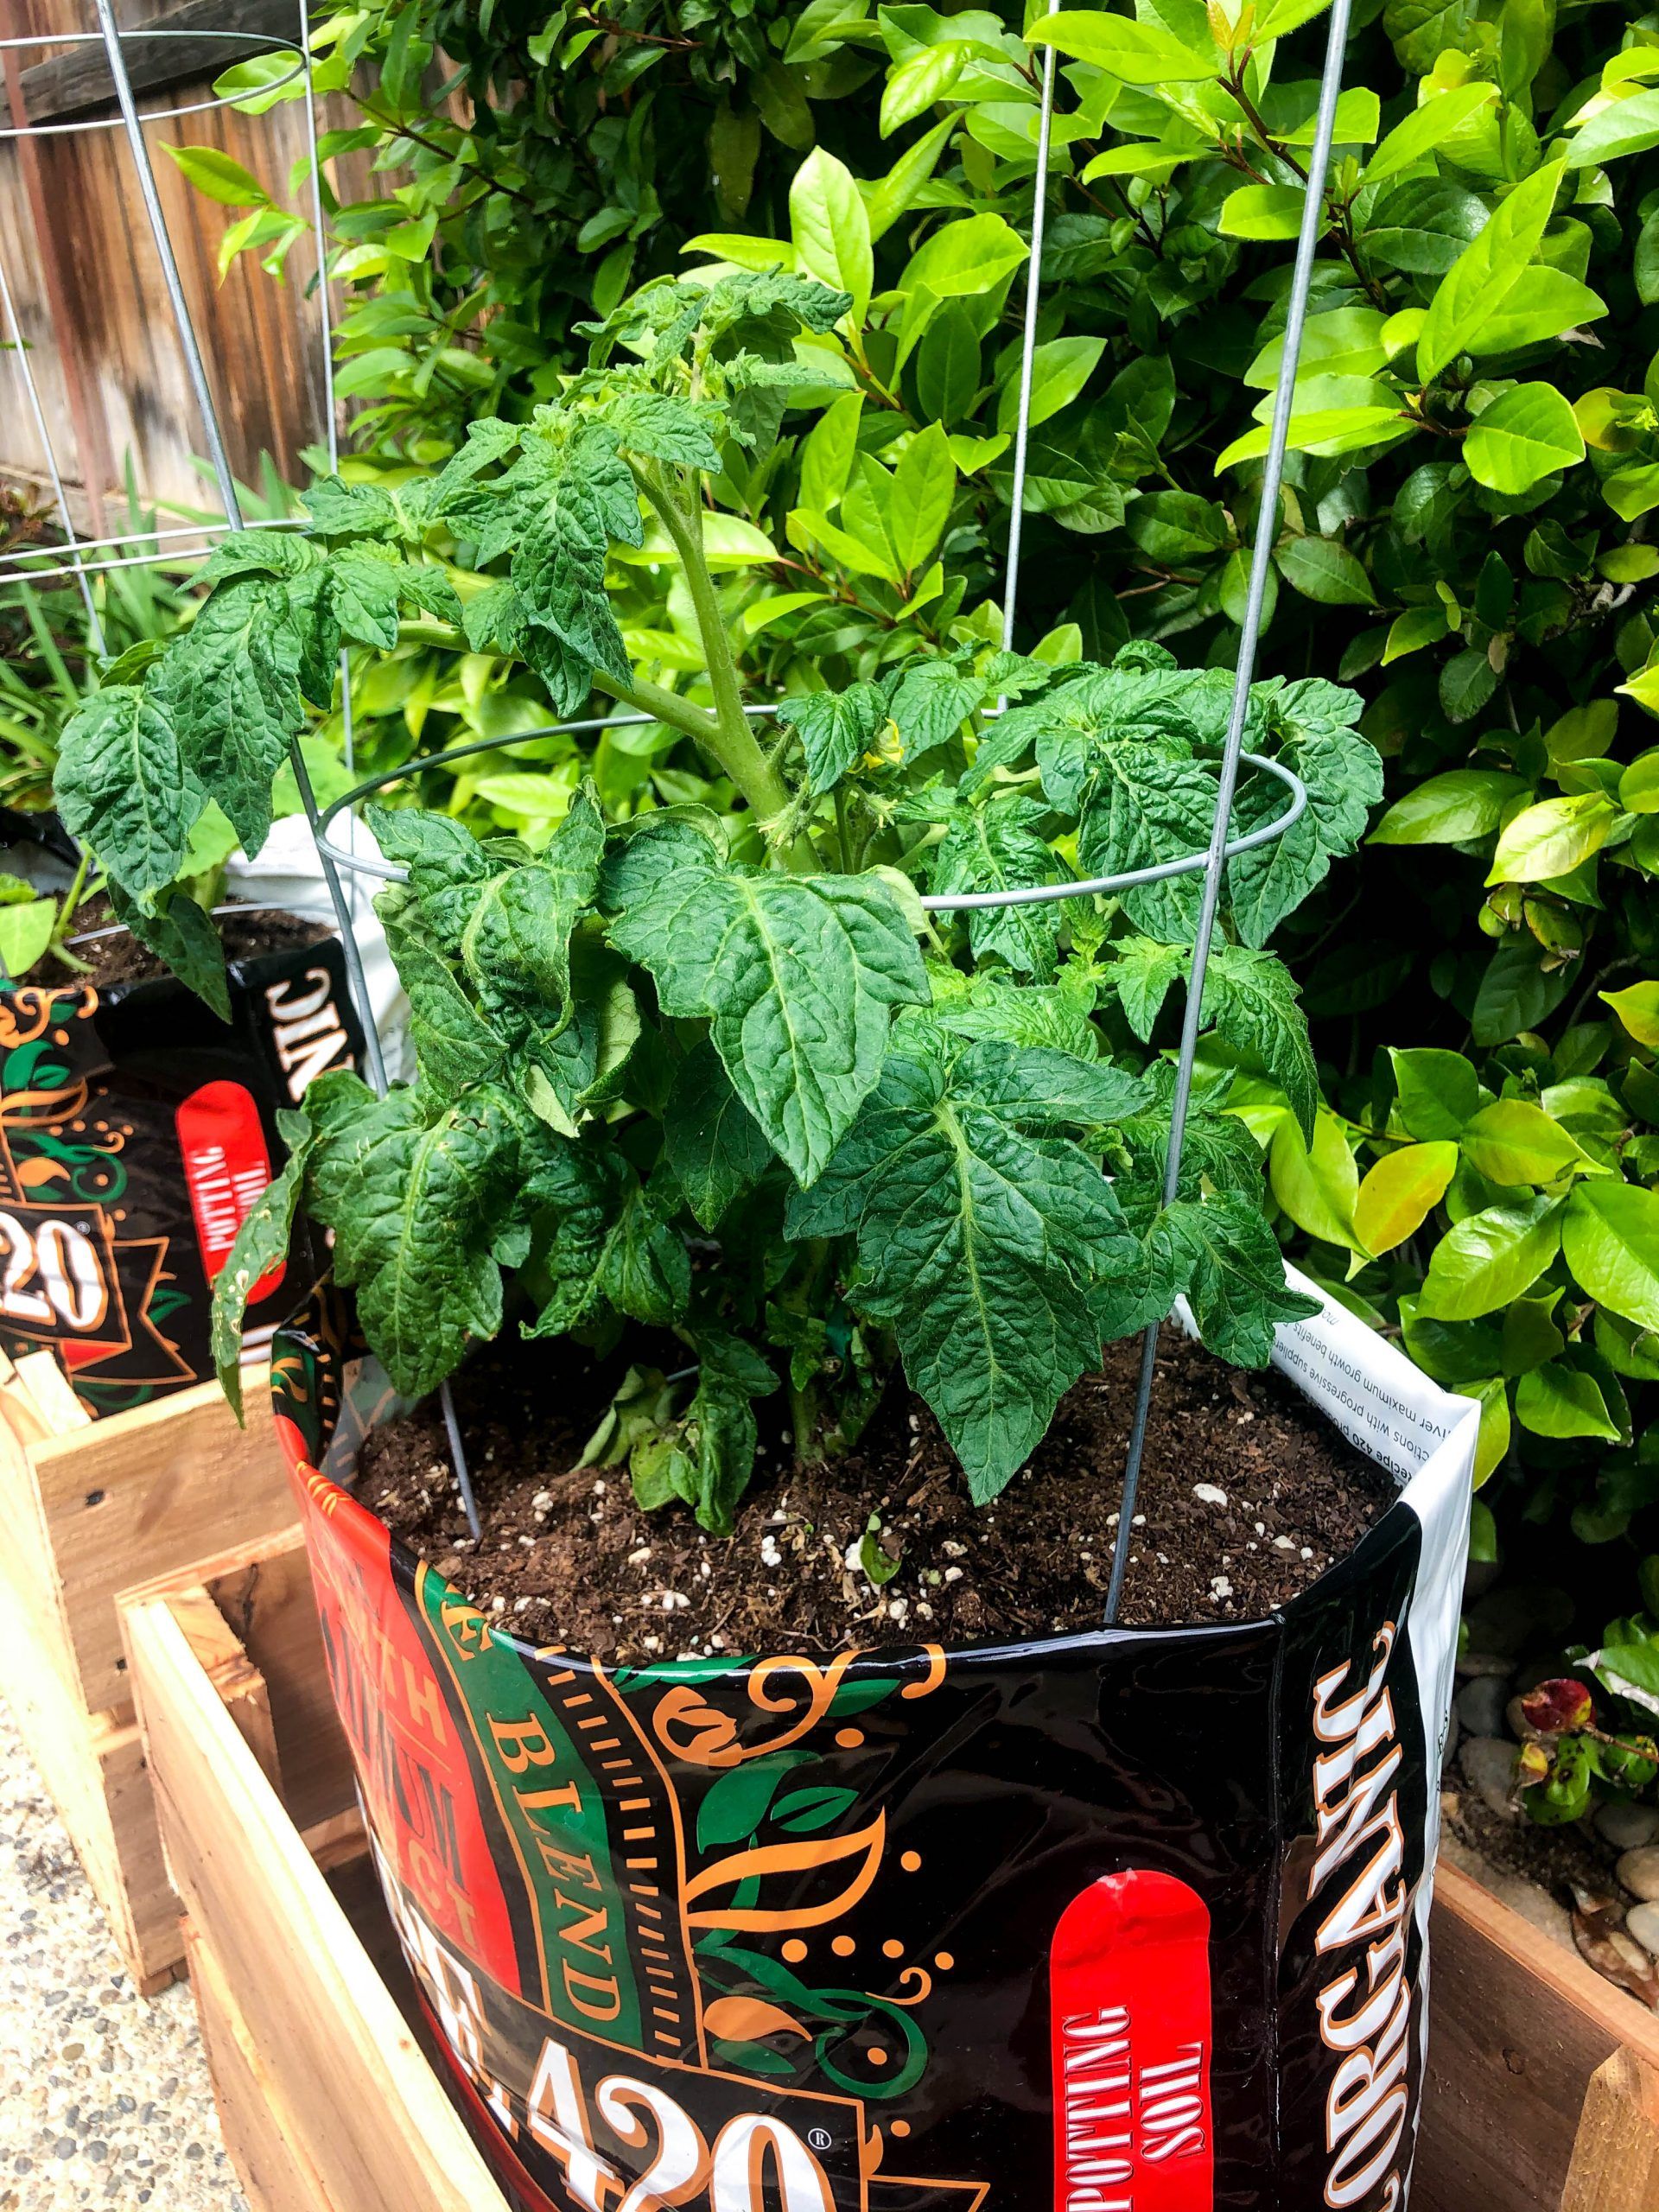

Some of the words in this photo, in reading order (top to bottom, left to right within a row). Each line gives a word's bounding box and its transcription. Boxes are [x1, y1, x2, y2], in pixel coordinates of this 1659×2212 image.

[188, 1146, 238, 1252] POTTING
[231, 1160, 268, 1220] OIL
[1293, 1322, 1328, 1358] benefits
[1328, 1351, 1362, 1384] growth
[1309, 1370, 1365, 1418] progressive
[1363, 1381, 1417, 1421] maximum
[1351, 1433, 1375, 1454] 420
[1365, 1411, 1391, 1437] with
[1418, 1414, 1452, 1438] iver
[486, 1711, 621, 2022] BLEND
[1306, 1620, 1413, 2210] ORGANIC
[1062, 2005, 1134, 2212] POTTING
[1140, 2040, 1207, 2163] SOIL
